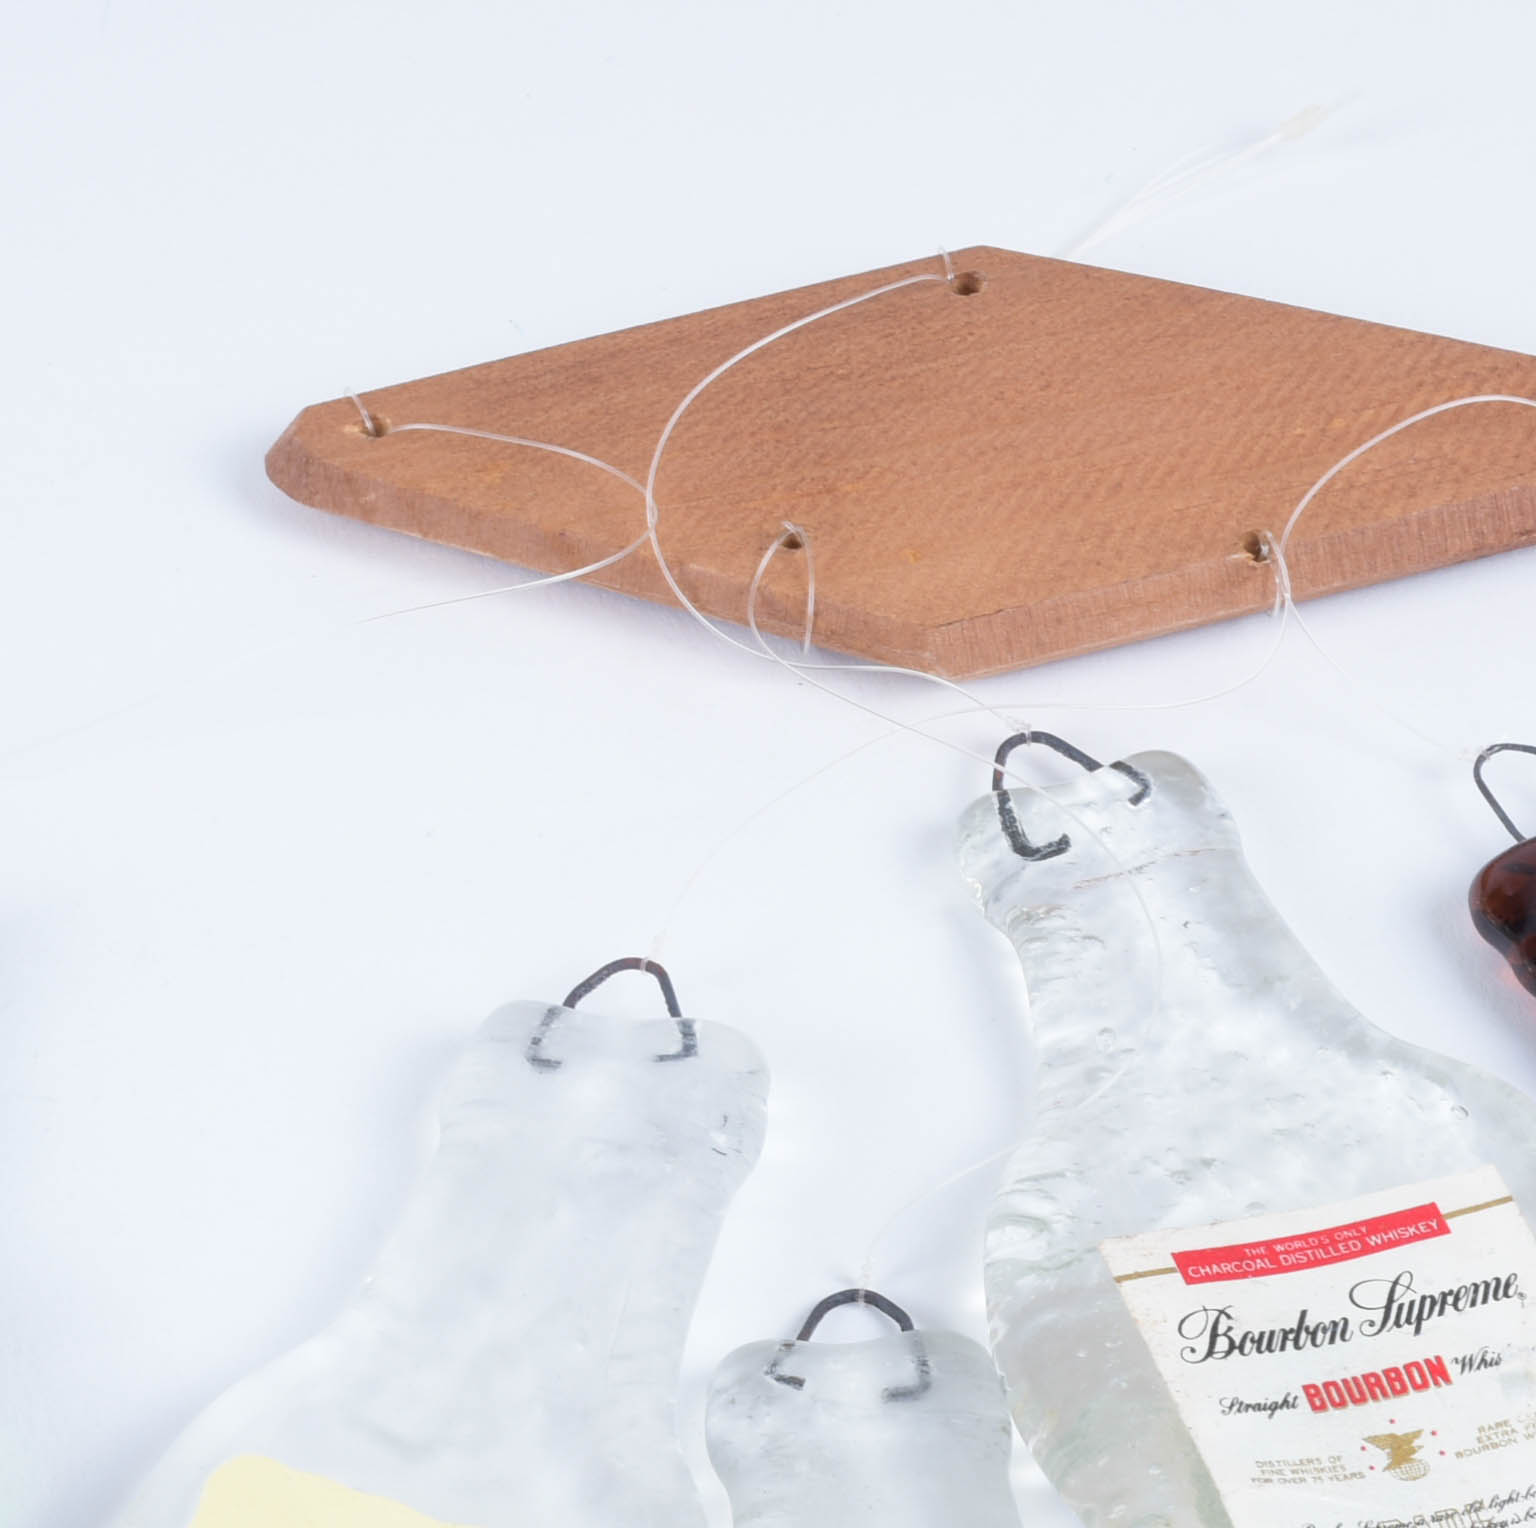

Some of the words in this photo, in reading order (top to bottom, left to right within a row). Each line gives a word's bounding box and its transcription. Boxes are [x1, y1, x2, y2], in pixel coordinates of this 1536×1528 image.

[1187, 1257, 1277, 1278] CHARCOAL
[1278, 1239, 1362, 1267] DISTILLED
[1365, 1218, 1438, 1247] WHISKEY
[1243, 1246, 1267, 1257] THE
[1333, 1225, 1367, 1241] ONLY
[1177, 1305, 1350, 1364] Bourbon
[1348, 1270, 1518, 1337] Supreme
[1218, 1391, 1299, 1419] Straight
[1302, 1355, 1452, 1413] BOURBON
